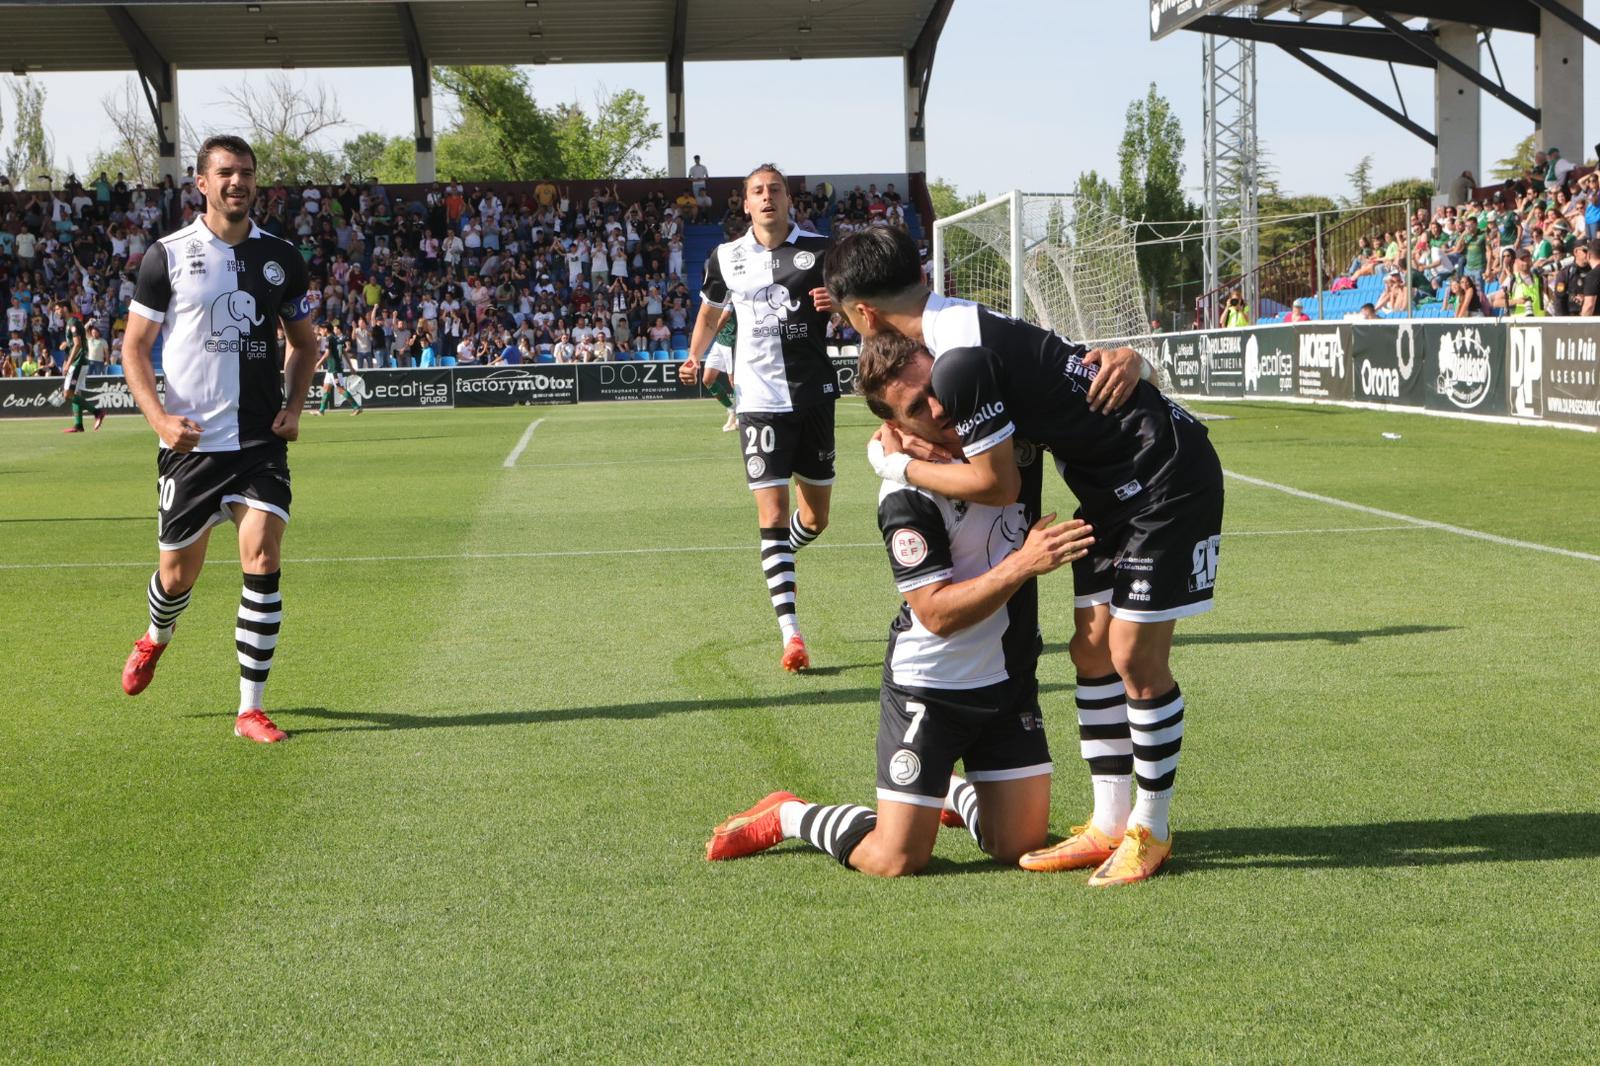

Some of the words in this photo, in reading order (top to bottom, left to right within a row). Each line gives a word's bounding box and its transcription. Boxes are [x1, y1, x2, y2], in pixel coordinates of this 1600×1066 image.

[205, 337, 267, 352] ecotisa
[1299, 326, 1344, 379] MORETA
[1260, 347, 1293, 376] ecotisa
[1361, 359, 1400, 397] Orona
[1550, 368, 1600, 385] ASESORÍ
[375, 380, 448, 398] ecotisa
[420, 396, 448, 405] grupo
[745, 425, 775, 455] 20
[1128, 592, 1151, 601] errea
[903, 701, 927, 743] 7
